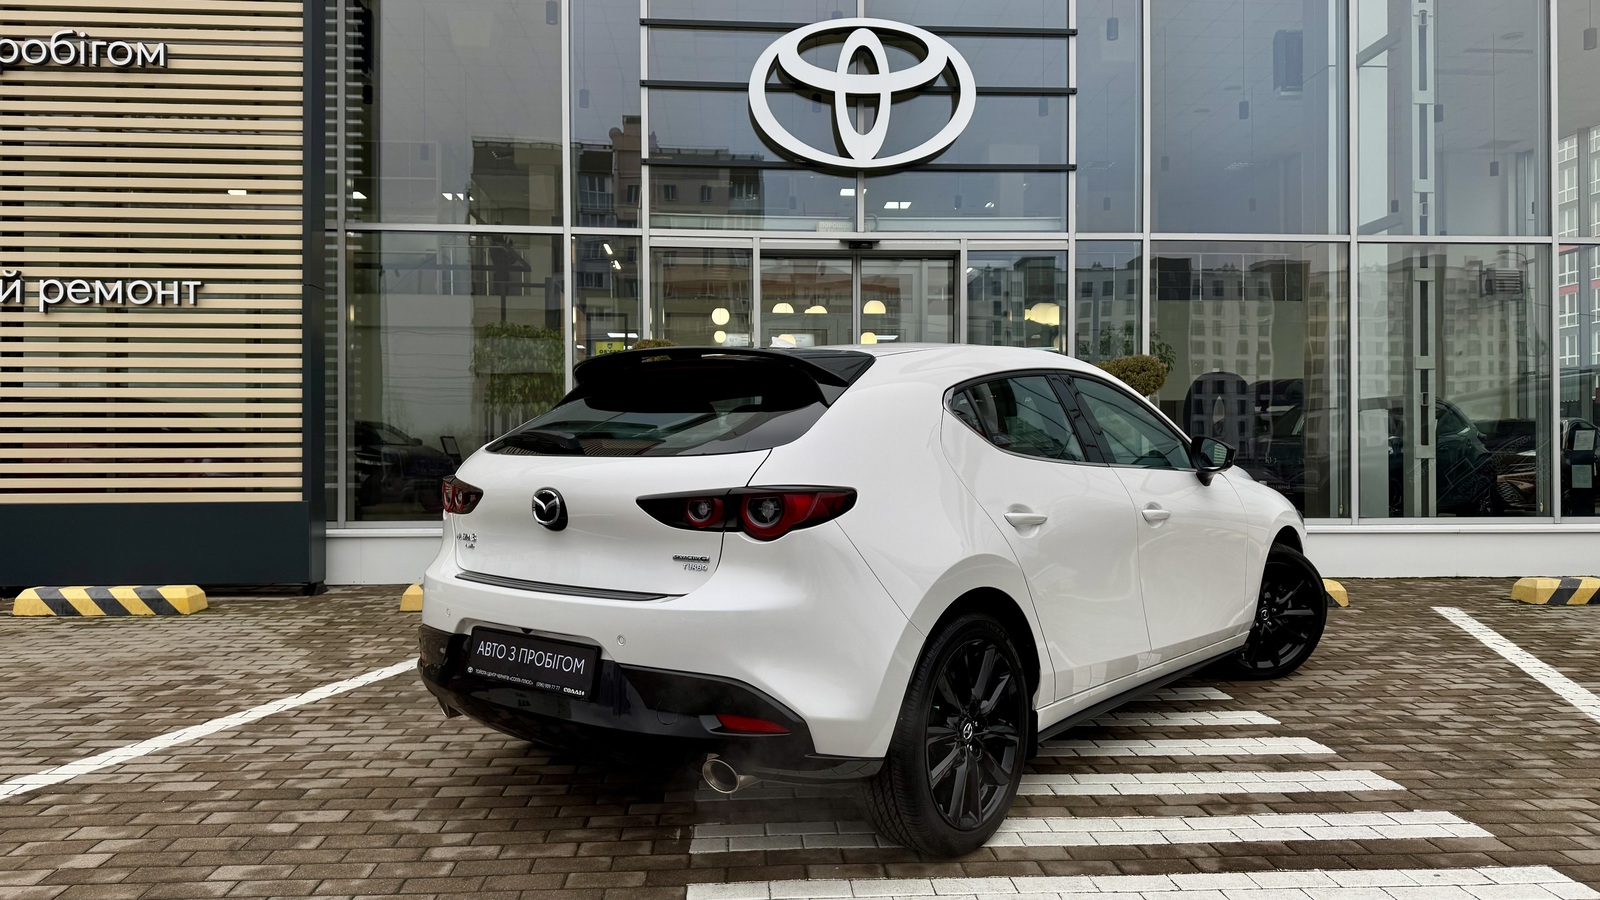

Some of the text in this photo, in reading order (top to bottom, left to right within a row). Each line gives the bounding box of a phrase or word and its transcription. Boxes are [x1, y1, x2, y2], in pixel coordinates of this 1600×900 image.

[39, 279, 202, 313] ремонт
[683, 563, 708, 572] TURBO
[476, 640, 507, 659] АВТО
[518, 647, 586, 675] ПРОБІГОМ
